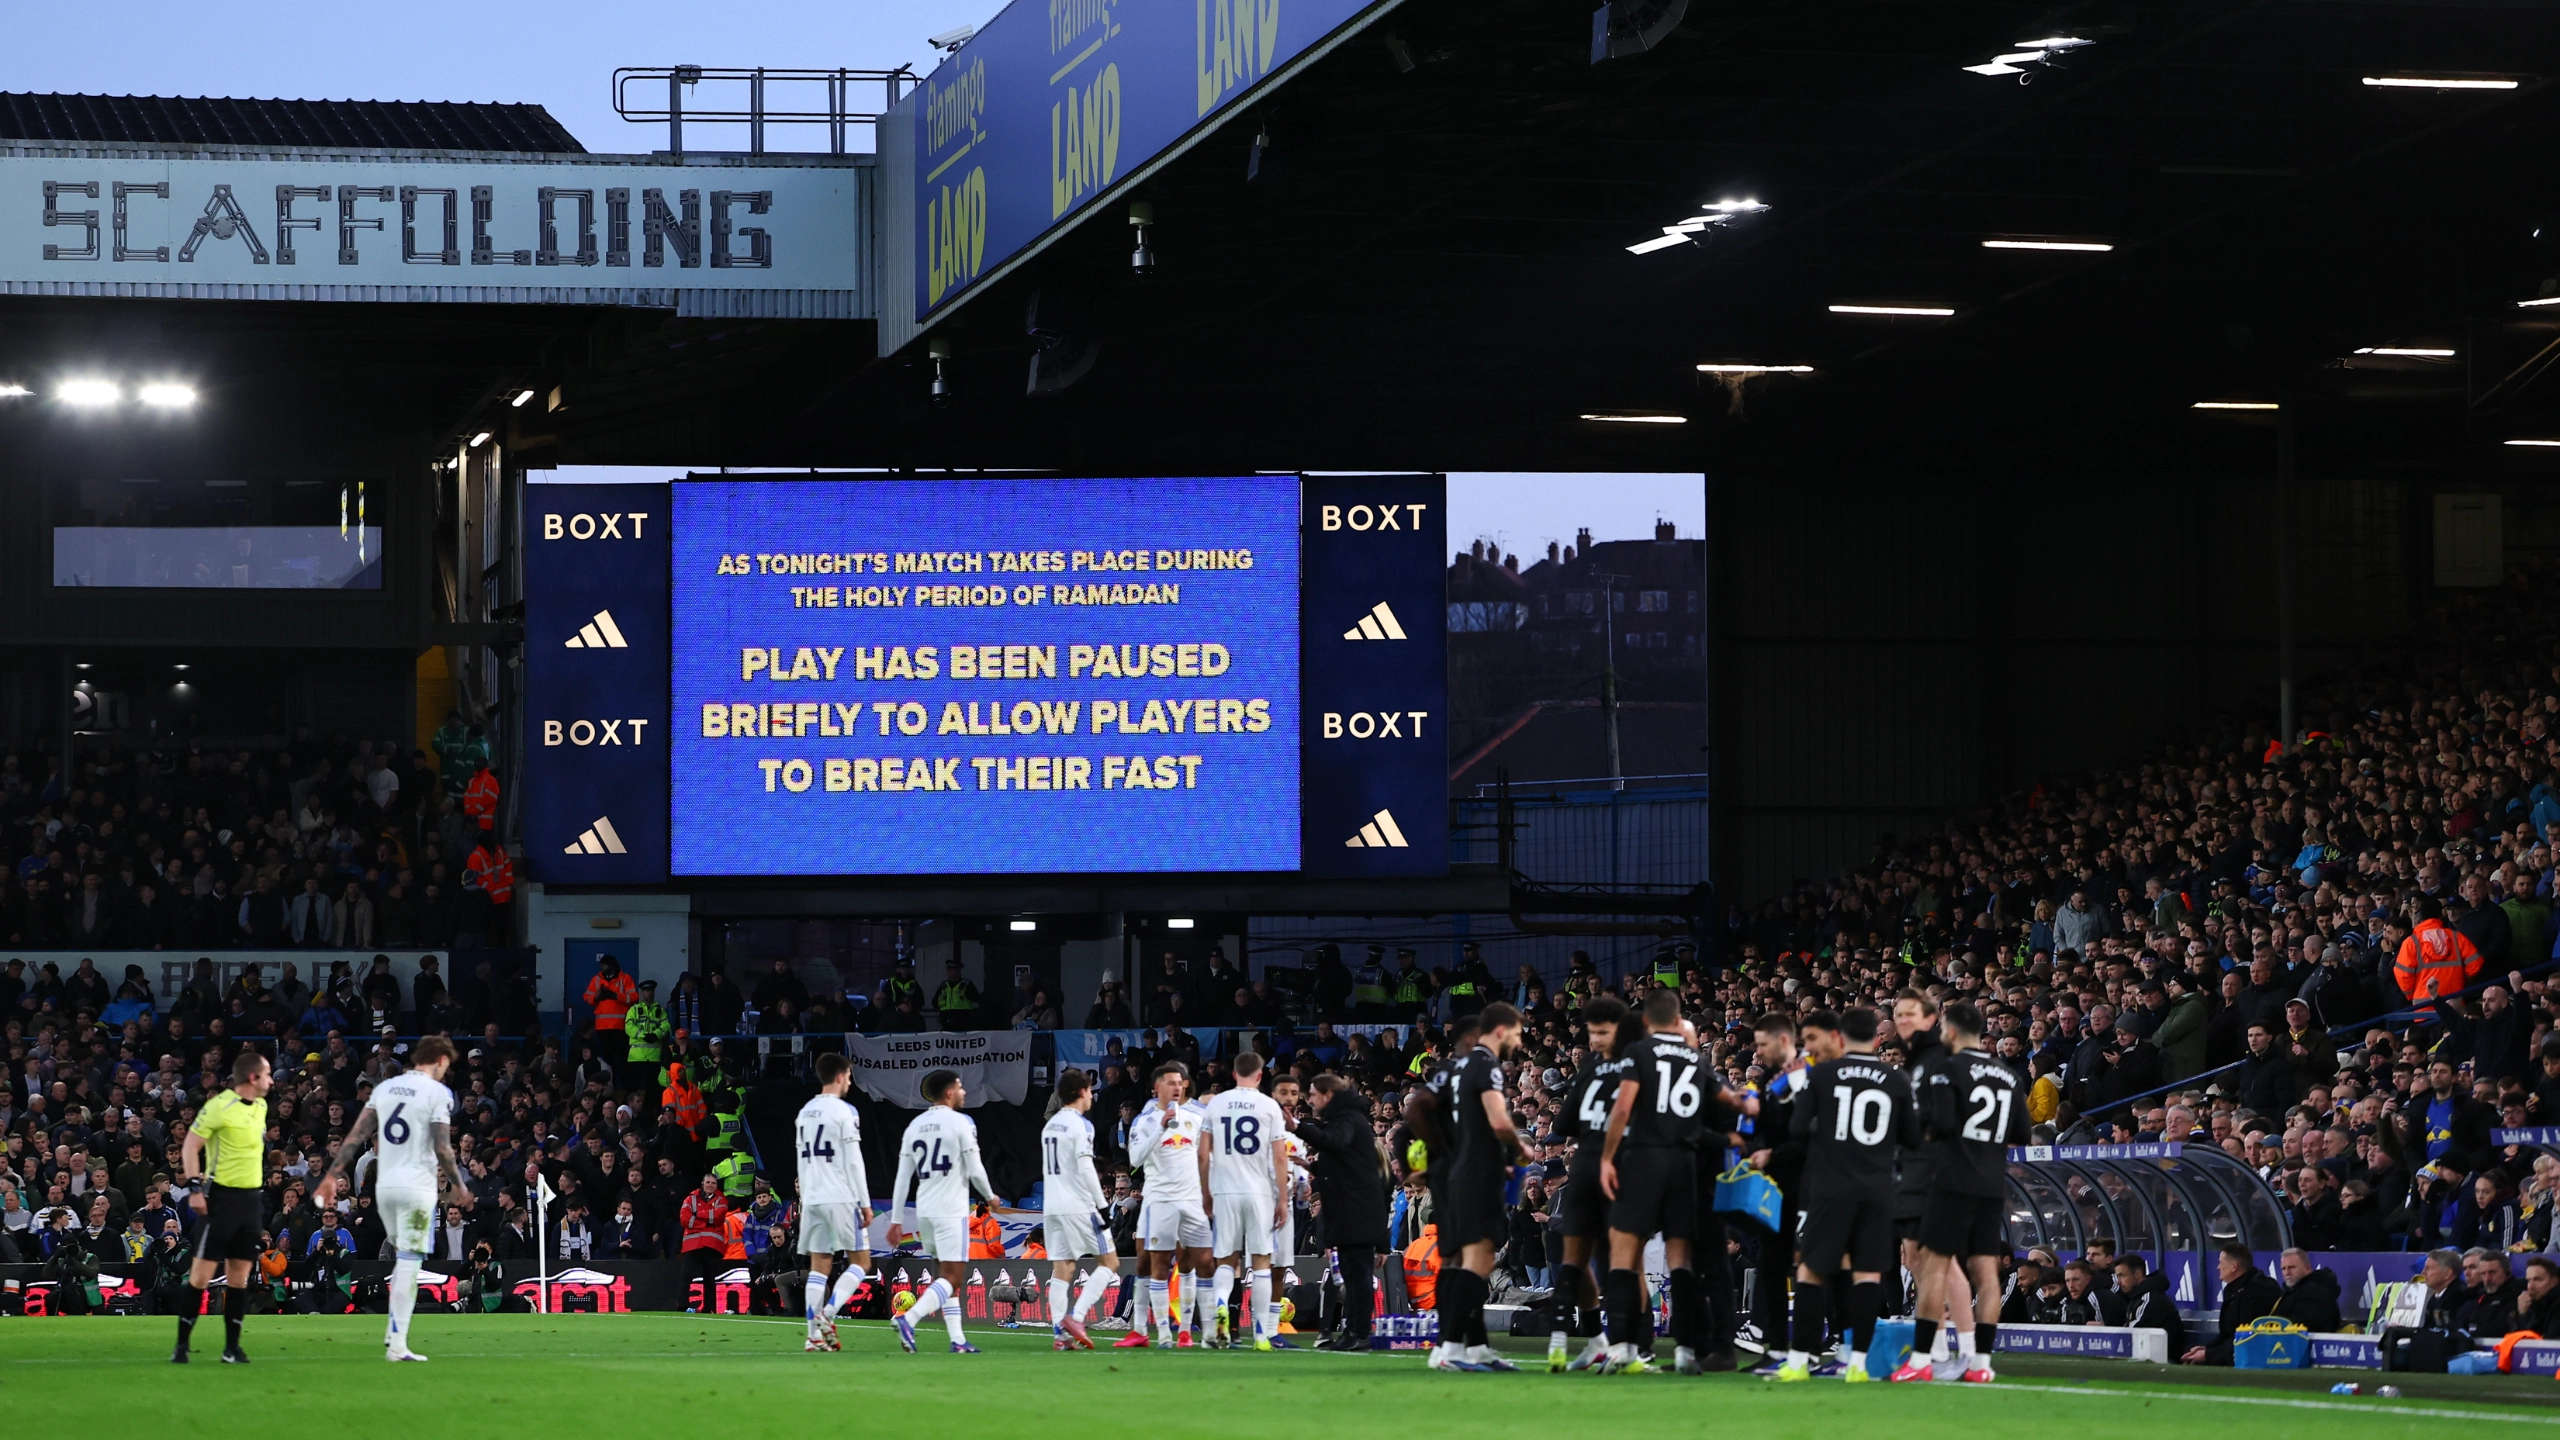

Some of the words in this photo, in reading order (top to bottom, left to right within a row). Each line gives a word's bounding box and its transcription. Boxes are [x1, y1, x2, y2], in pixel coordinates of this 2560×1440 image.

[927, 54, 985, 157] flamingo
[1052, 62, 1121, 221] LAND
[42, 179, 774, 269] SCAFFOLDING
[928, 165, 987, 308] LAND
[544, 513, 648, 541] BOXT
[1322, 504, 1427, 532] BOXT
[717, 553, 751, 575] AS
[756, 552, 889, 574] TONIGHT'S
[895, 551, 982, 573] MATCH
[988, 550, 1066, 572] TAKES
[1071, 550, 1150, 572] PLACE
[1156, 549, 1254, 571] DURING
[790, 587, 838, 608] THE
[845, 586, 909, 607] HOLY
[914, 585, 1007, 607] PERIOD
[1013, 585, 1047, 606] OF
[1053, 584, 1179, 605] RAMADAN
[742, 647, 844, 680] PLAY
[855, 646, 940, 680] HAS
[950, 645, 1056, 678] BEEN
[1069, 643, 1230, 678] PAUSED
[544, 719, 648, 746] BOXT
[702, 702, 863, 737] BRIEFLY
[872, 702, 928, 736] TO
[937, 700, 1080, 735] ALLOW
[1091, 699, 1272, 735] PLAYERS
[1322, 711, 1428, 739] BOXT
[757, 758, 813, 792] TO
[825, 757, 961, 792] BREAK
[971, 756, 1092, 791] THEIR
[1103, 755, 1203, 789] FAST
[851, 1054, 918, 1070] DISABLED
[922, 1050, 1025, 1068] ORGANISATION
[887, 1040, 931, 1053] LEEDS
[935, 1037, 987, 1050] UNITED
[1655, 1059, 1701, 1119] 16
[1837, 1065, 1888, 1085] CHERKI
[384, 1102, 411, 1145] 6
[1227, 1101, 1256, 1111] STACH
[1833, 1084, 1893, 1146] 10
[1961, 1084, 2013, 1144] 21
[1220, 1115, 1261, 1156] 18
[912, 1137, 953, 1180] 24
[1044, 1136, 1062, 1175] 11
[512, 1275, 632, 1314] amt
